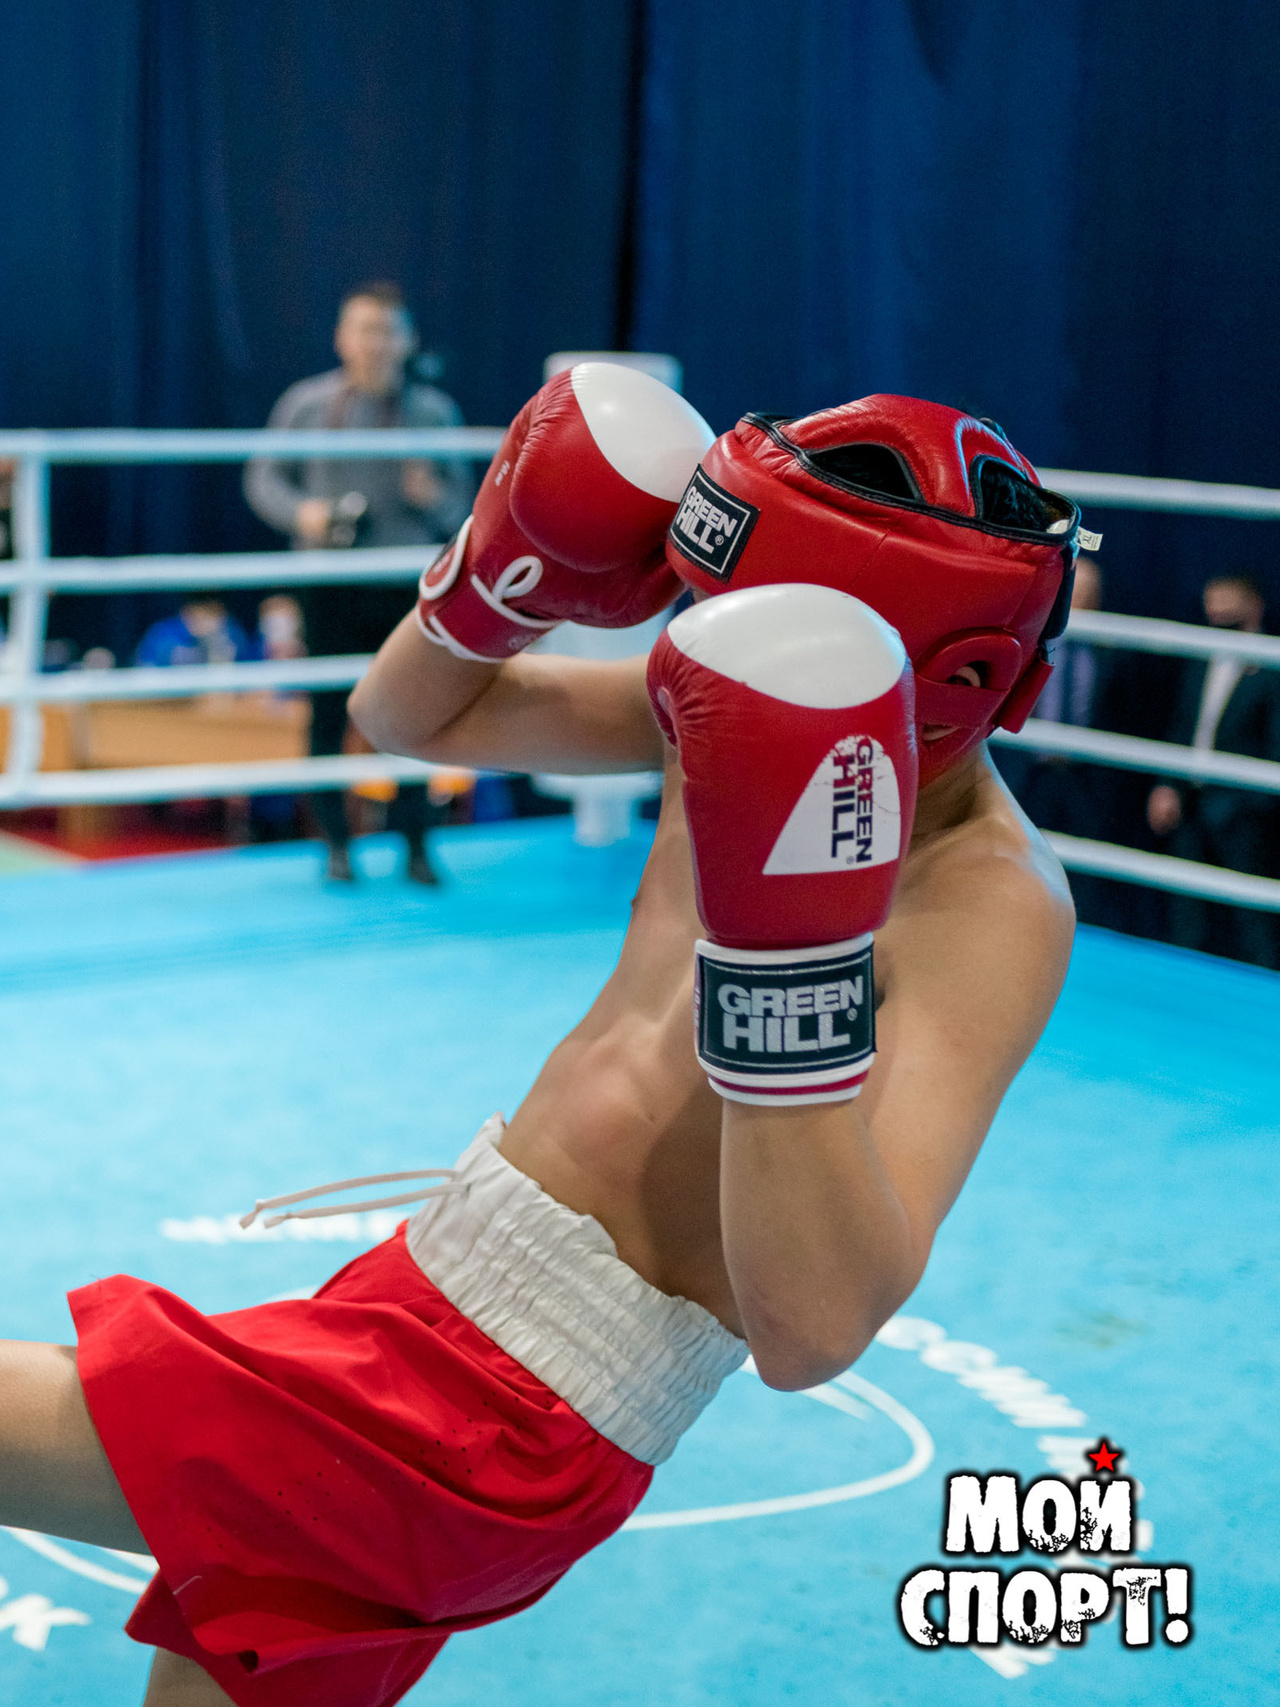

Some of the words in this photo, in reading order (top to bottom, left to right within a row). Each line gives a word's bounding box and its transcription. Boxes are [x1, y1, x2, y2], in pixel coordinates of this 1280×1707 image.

[676, 502, 715, 554] HILL
[686, 485, 738, 537] GREEN
[831, 753, 855, 858] HILL
[856, 737, 873, 863] GREEN
[717, 975, 863, 1017] GREEN
[722, 1013, 851, 1053] HILL
